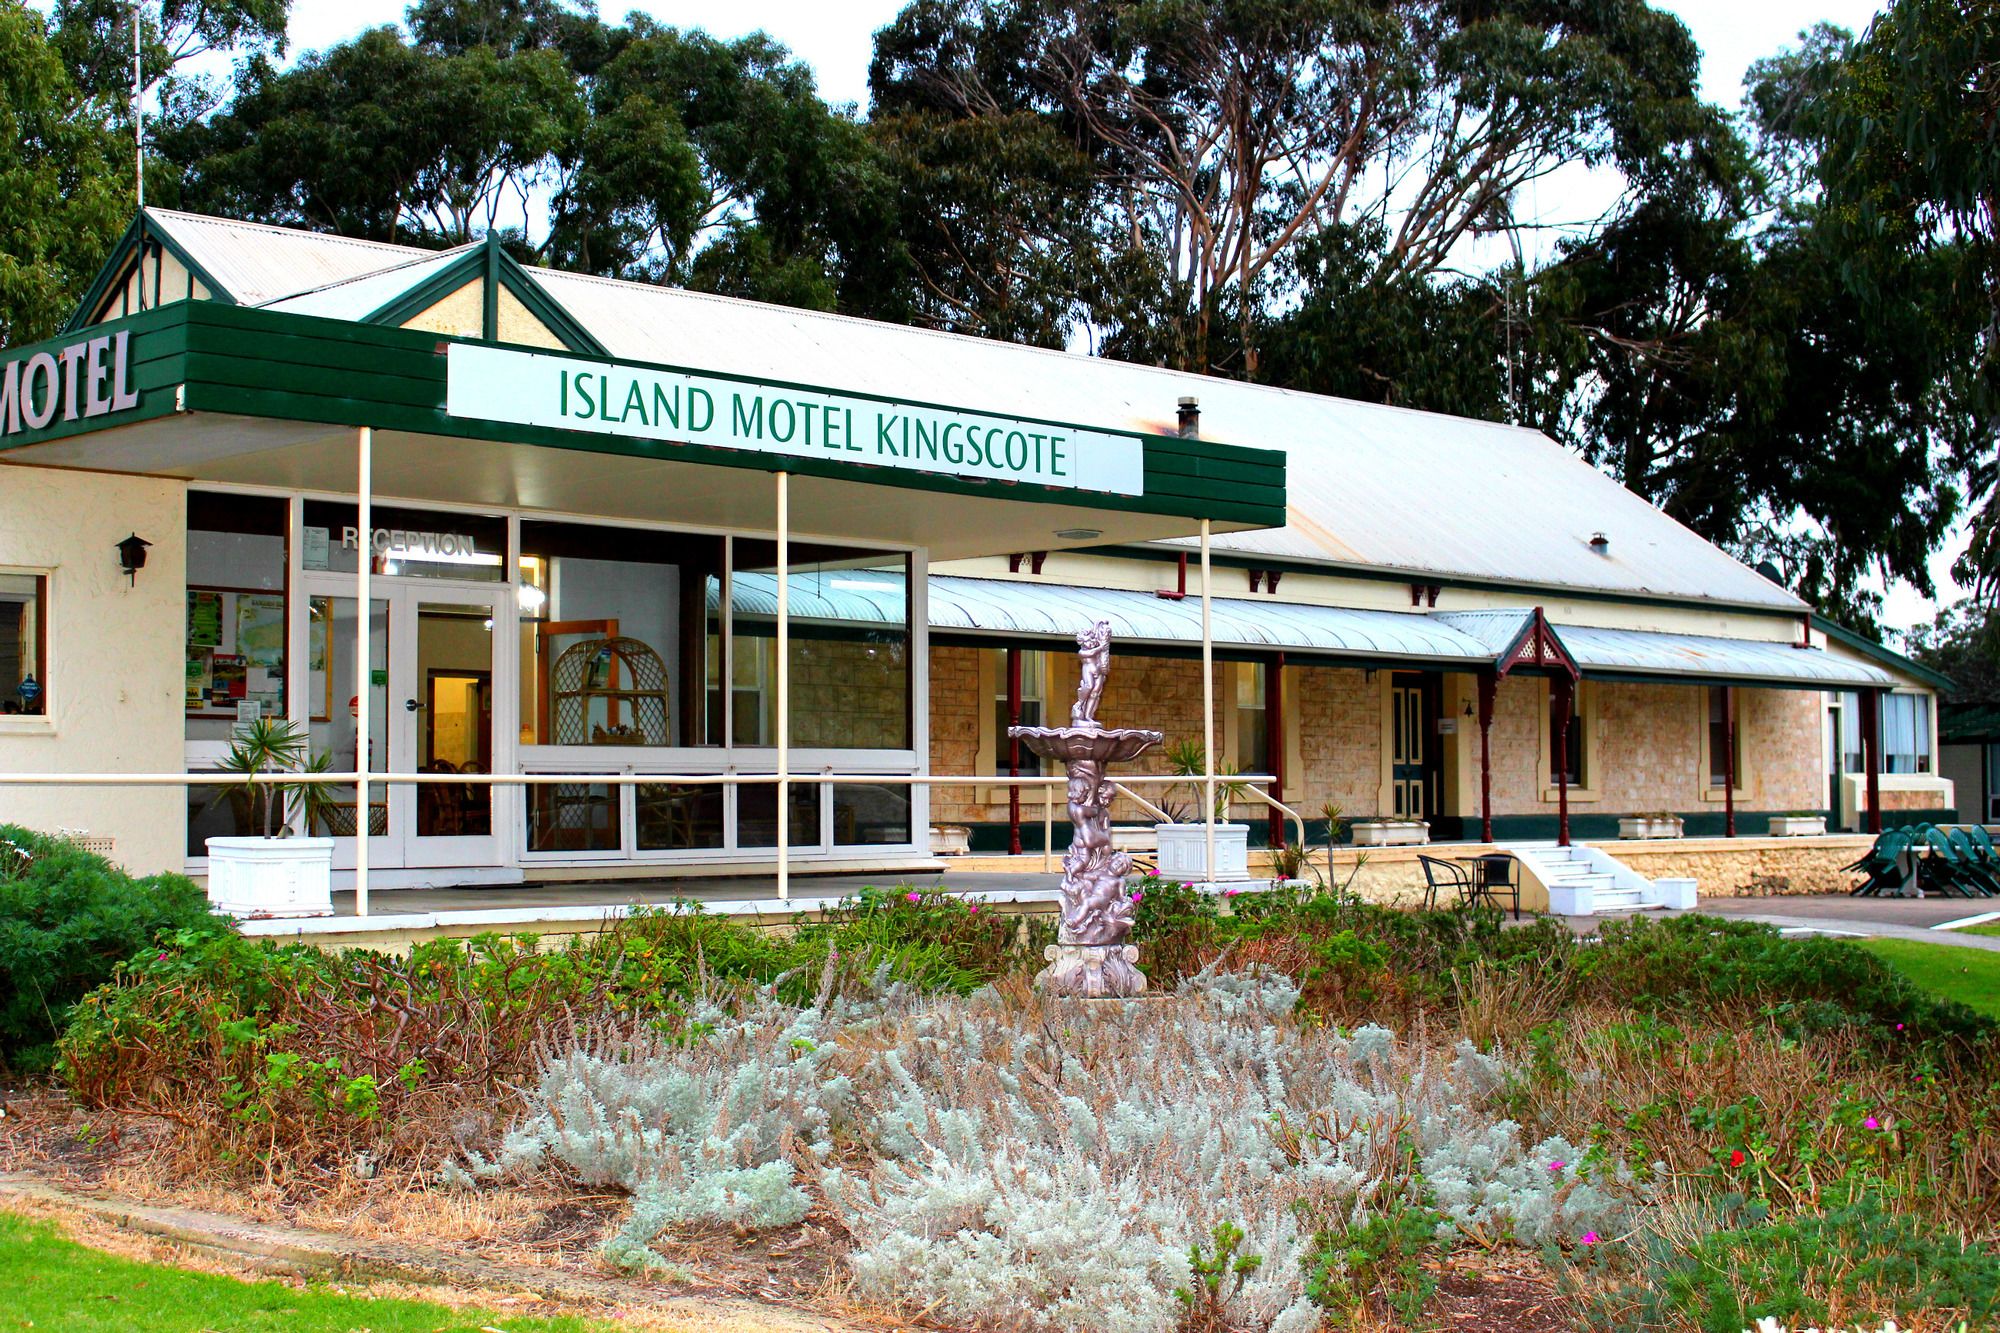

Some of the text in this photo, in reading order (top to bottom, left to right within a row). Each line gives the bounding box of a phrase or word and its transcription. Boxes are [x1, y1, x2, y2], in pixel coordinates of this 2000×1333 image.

[561, 370, 1066, 476] ISLAND MOTEL KINGSCOTE
[342, 526, 475, 557] RCEPTION
